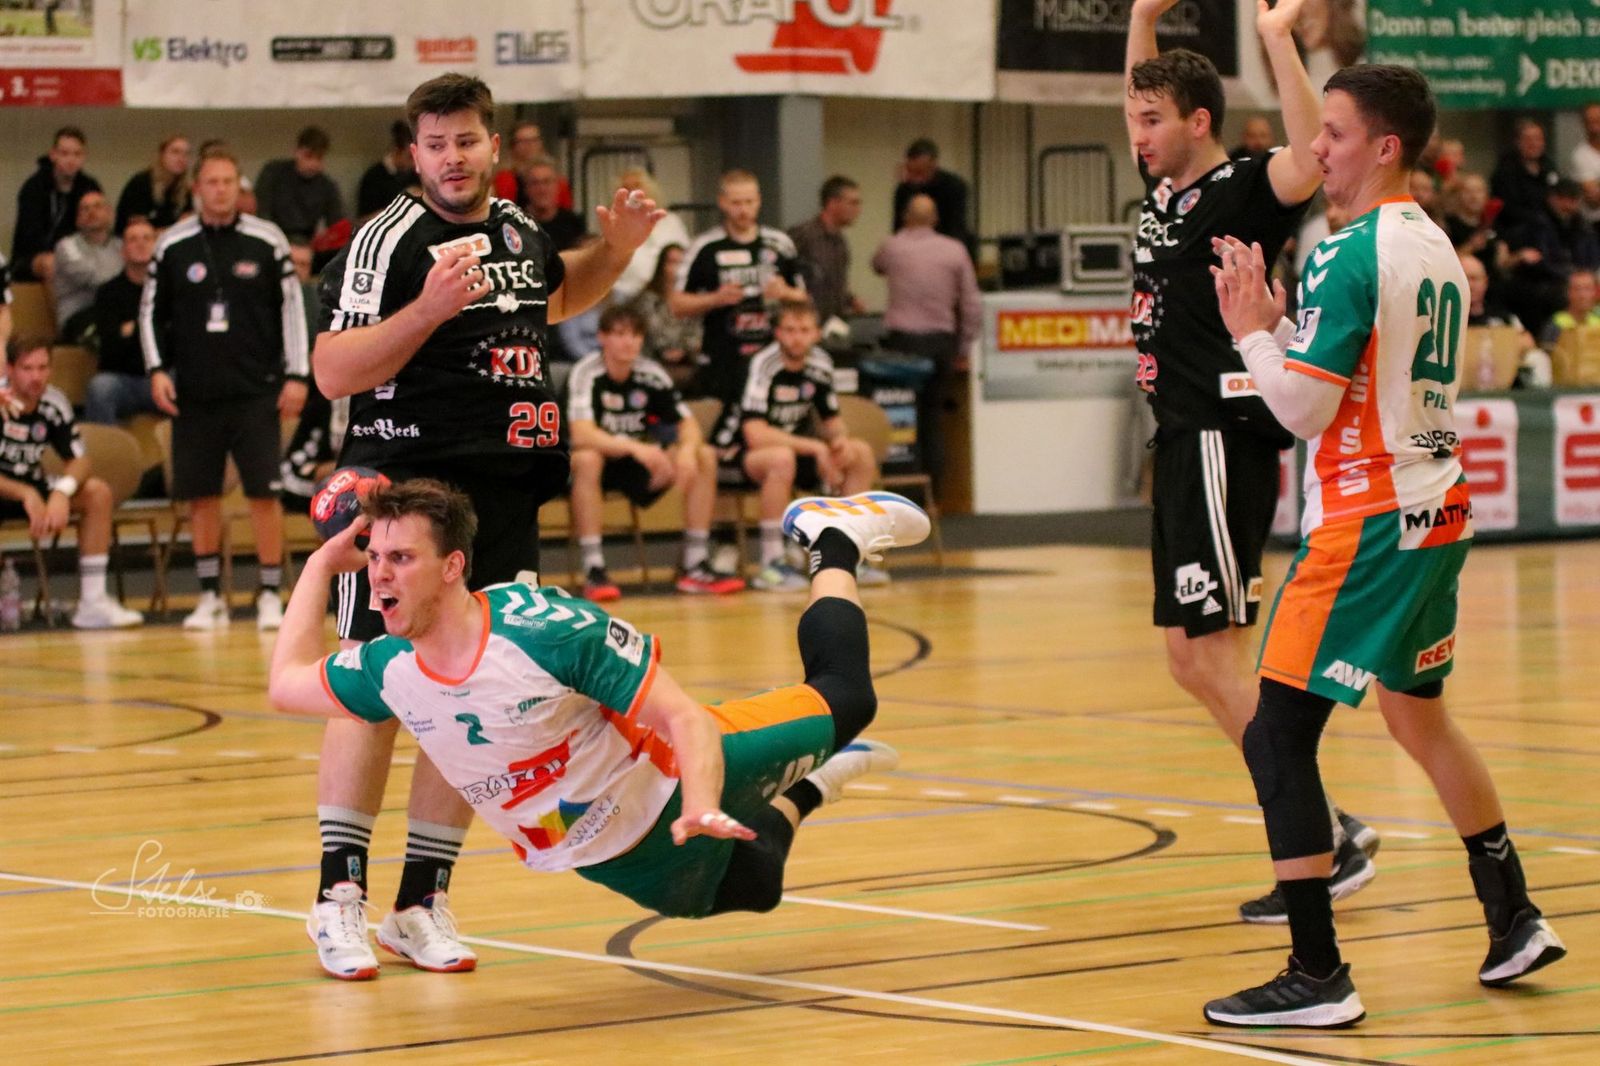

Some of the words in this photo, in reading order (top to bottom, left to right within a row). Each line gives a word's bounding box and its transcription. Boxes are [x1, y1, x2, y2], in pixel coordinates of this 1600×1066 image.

[133, 37, 163, 62] VS
[168, 37, 248, 68] Elektro
[1411, 278, 1462, 386] 20
[507, 401, 560, 448] 29
[1322, 659, 1377, 692] AW
[454, 712, 494, 746] 2
